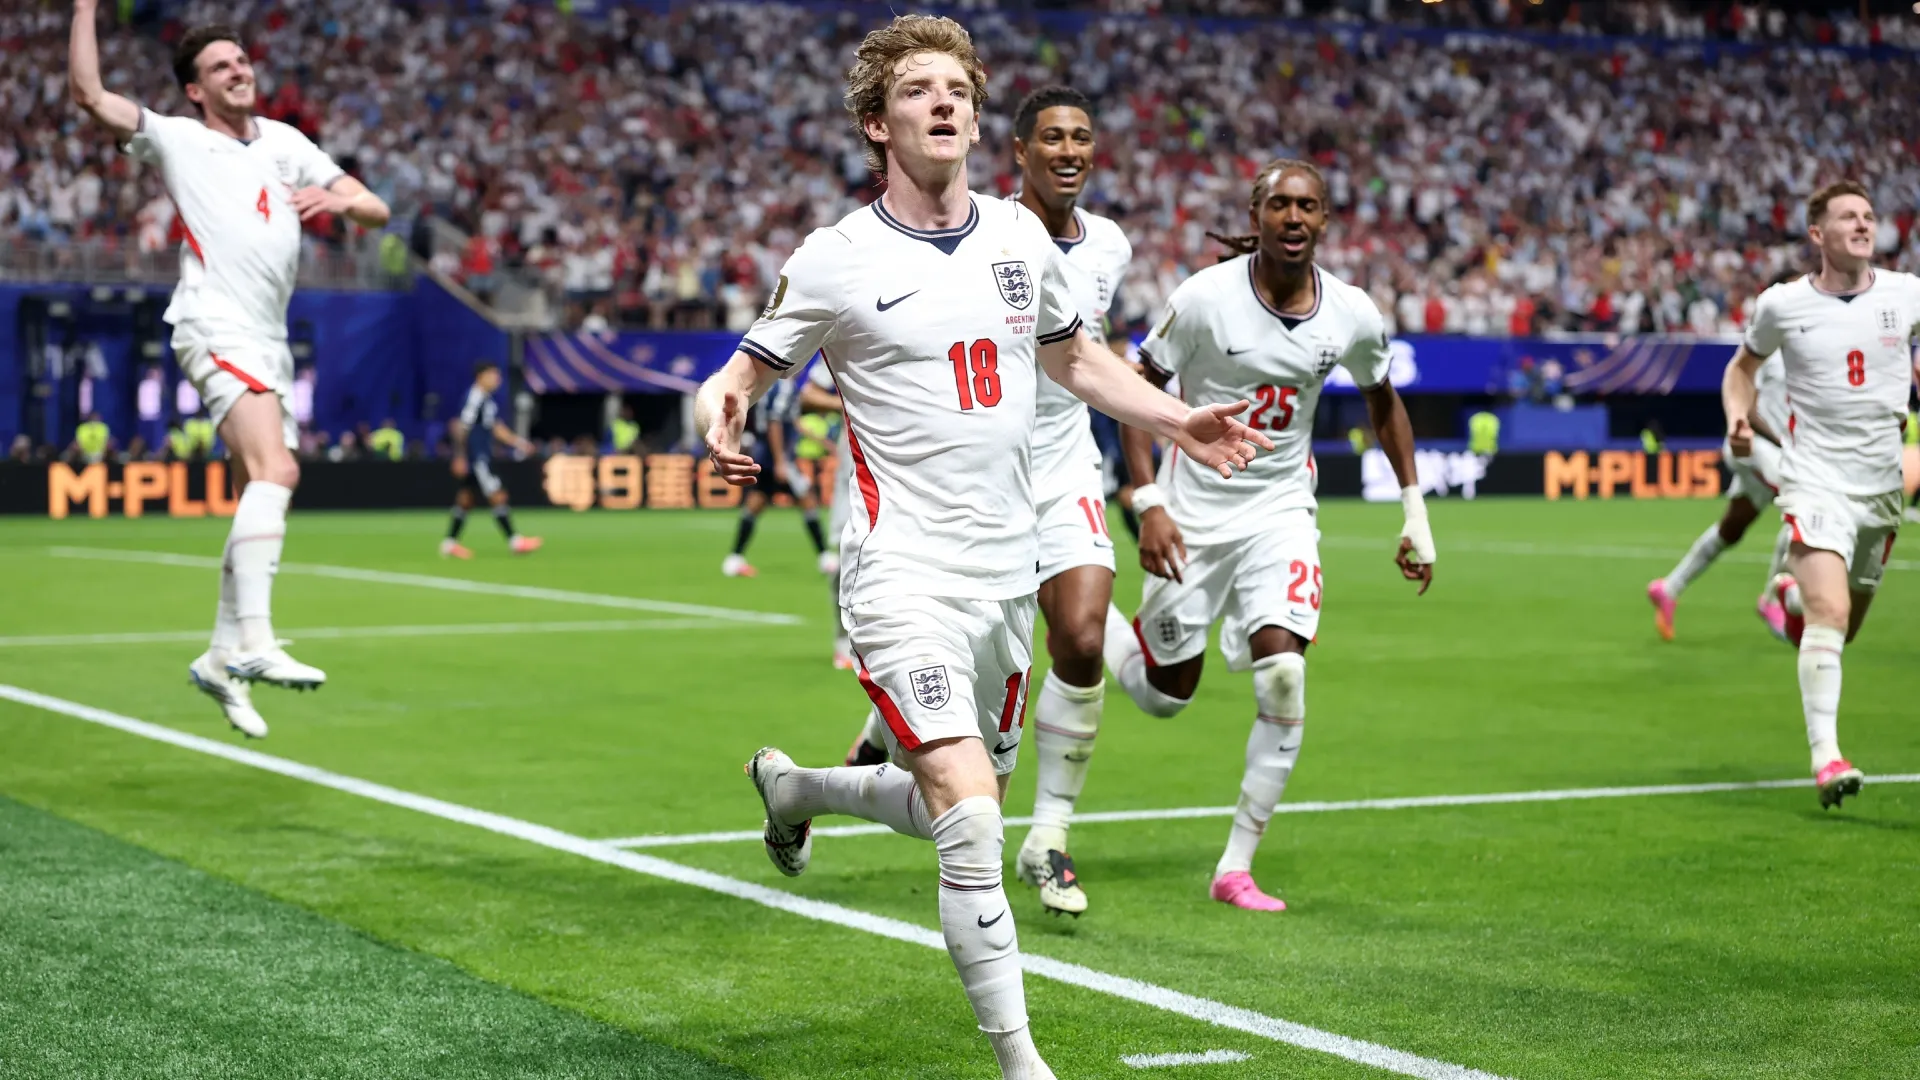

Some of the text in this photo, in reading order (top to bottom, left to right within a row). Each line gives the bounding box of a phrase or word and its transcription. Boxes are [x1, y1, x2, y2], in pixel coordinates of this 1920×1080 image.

[257, 187, 271, 224] 4
[948, 338, 1002, 411] 18
[1847, 350, 1865, 386] 8
[1249, 384, 1298, 431] 25
[998, 666, 1032, 733] 1
